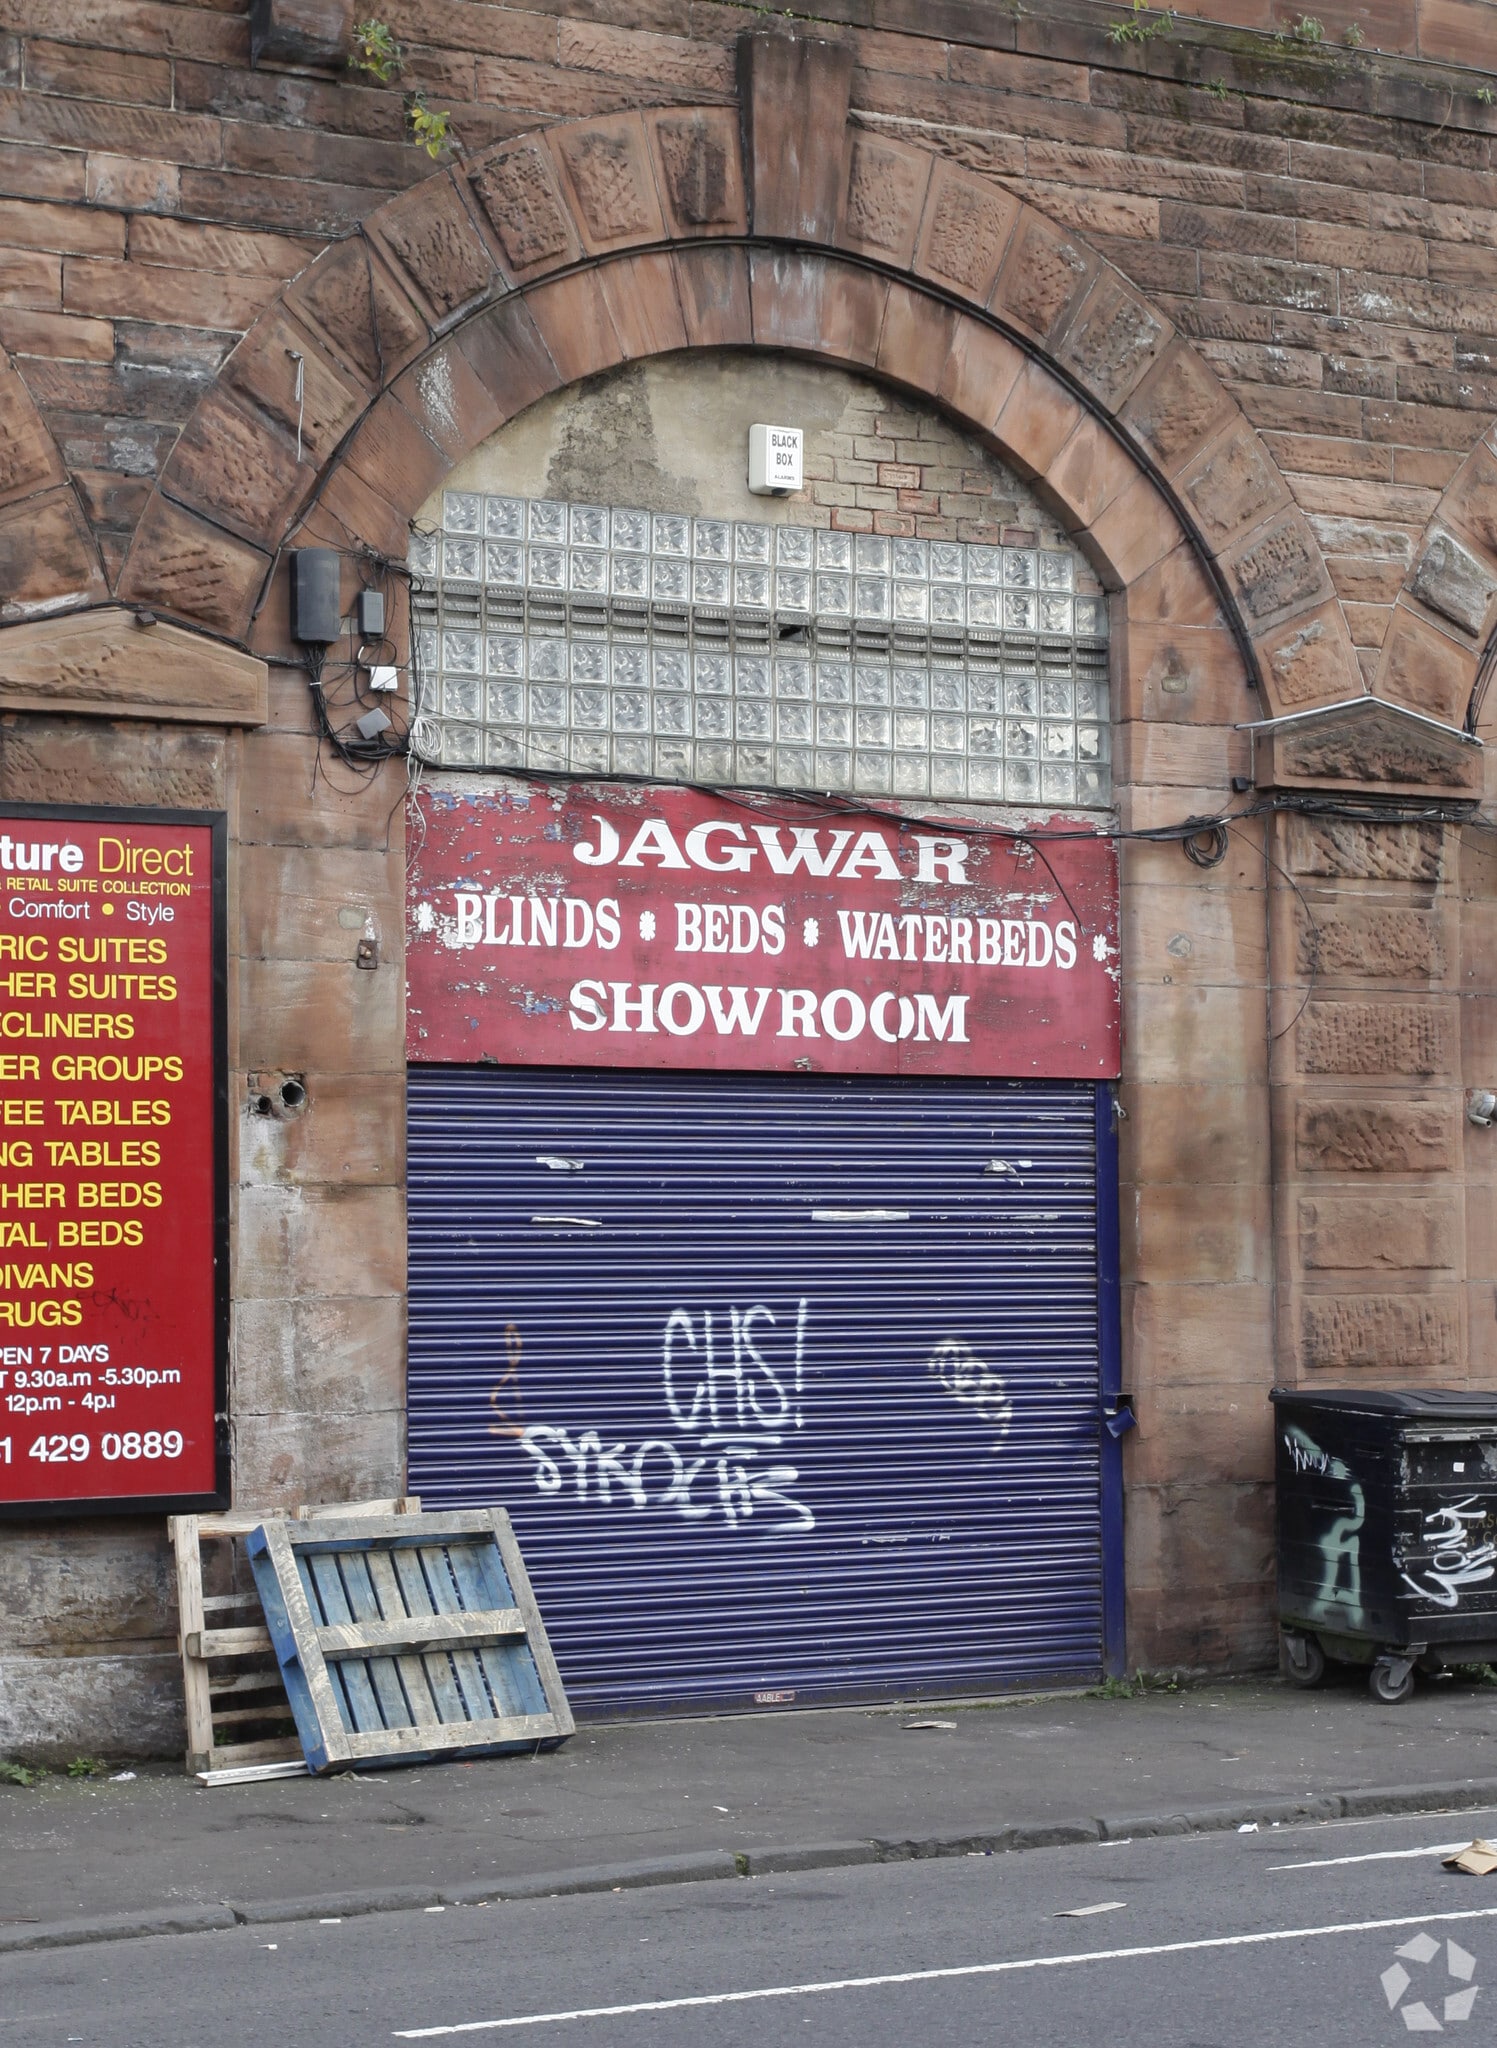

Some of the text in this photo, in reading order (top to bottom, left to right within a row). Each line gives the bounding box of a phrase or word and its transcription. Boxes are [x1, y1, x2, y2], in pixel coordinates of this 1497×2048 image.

[772, 434, 798, 448] BLACK
[776, 453, 793, 466] BOX
[0, 835, 193, 876] ture Direct
[572, 814, 970, 885] JAGWAR
[7, 877, 53, 891] RETAIL
[57, 878, 98, 893] SUITE
[102, 880, 190, 896] COLLECTION
[9, 897, 174, 926] Comfort Style
[455, 893, 1077, 969] BLINDS BEDS WATERBEDS
[58, 937, 167, 964] SUITES
[68, 973, 177, 1000] SUITES
[569, 980, 971, 1043] SHOWROOM
[0, 1012, 134, 1039] CLINERS
[0, 1055, 183, 1081] ER GROUPS
[0, 1100, 171, 1125] EE TABLES
[44, 1141, 160, 1166] TABLES
[2, 1182, 162, 1208] HER BEDS
[59, 1220, 143, 1246] BEDS
[0, 1262, 94, 1289] IVANS
[0, 1345, 109, 1365] EN 7 DAYS
[15, 1370, 91, 1388] 9.30a.m
[98, 1367, 180, 1388] -5.30p.m
[5, 1394, 61, 1415] 12p.m
[29, 1434, 90, 1462] 429
[101, 1431, 183, 1460] 0889
